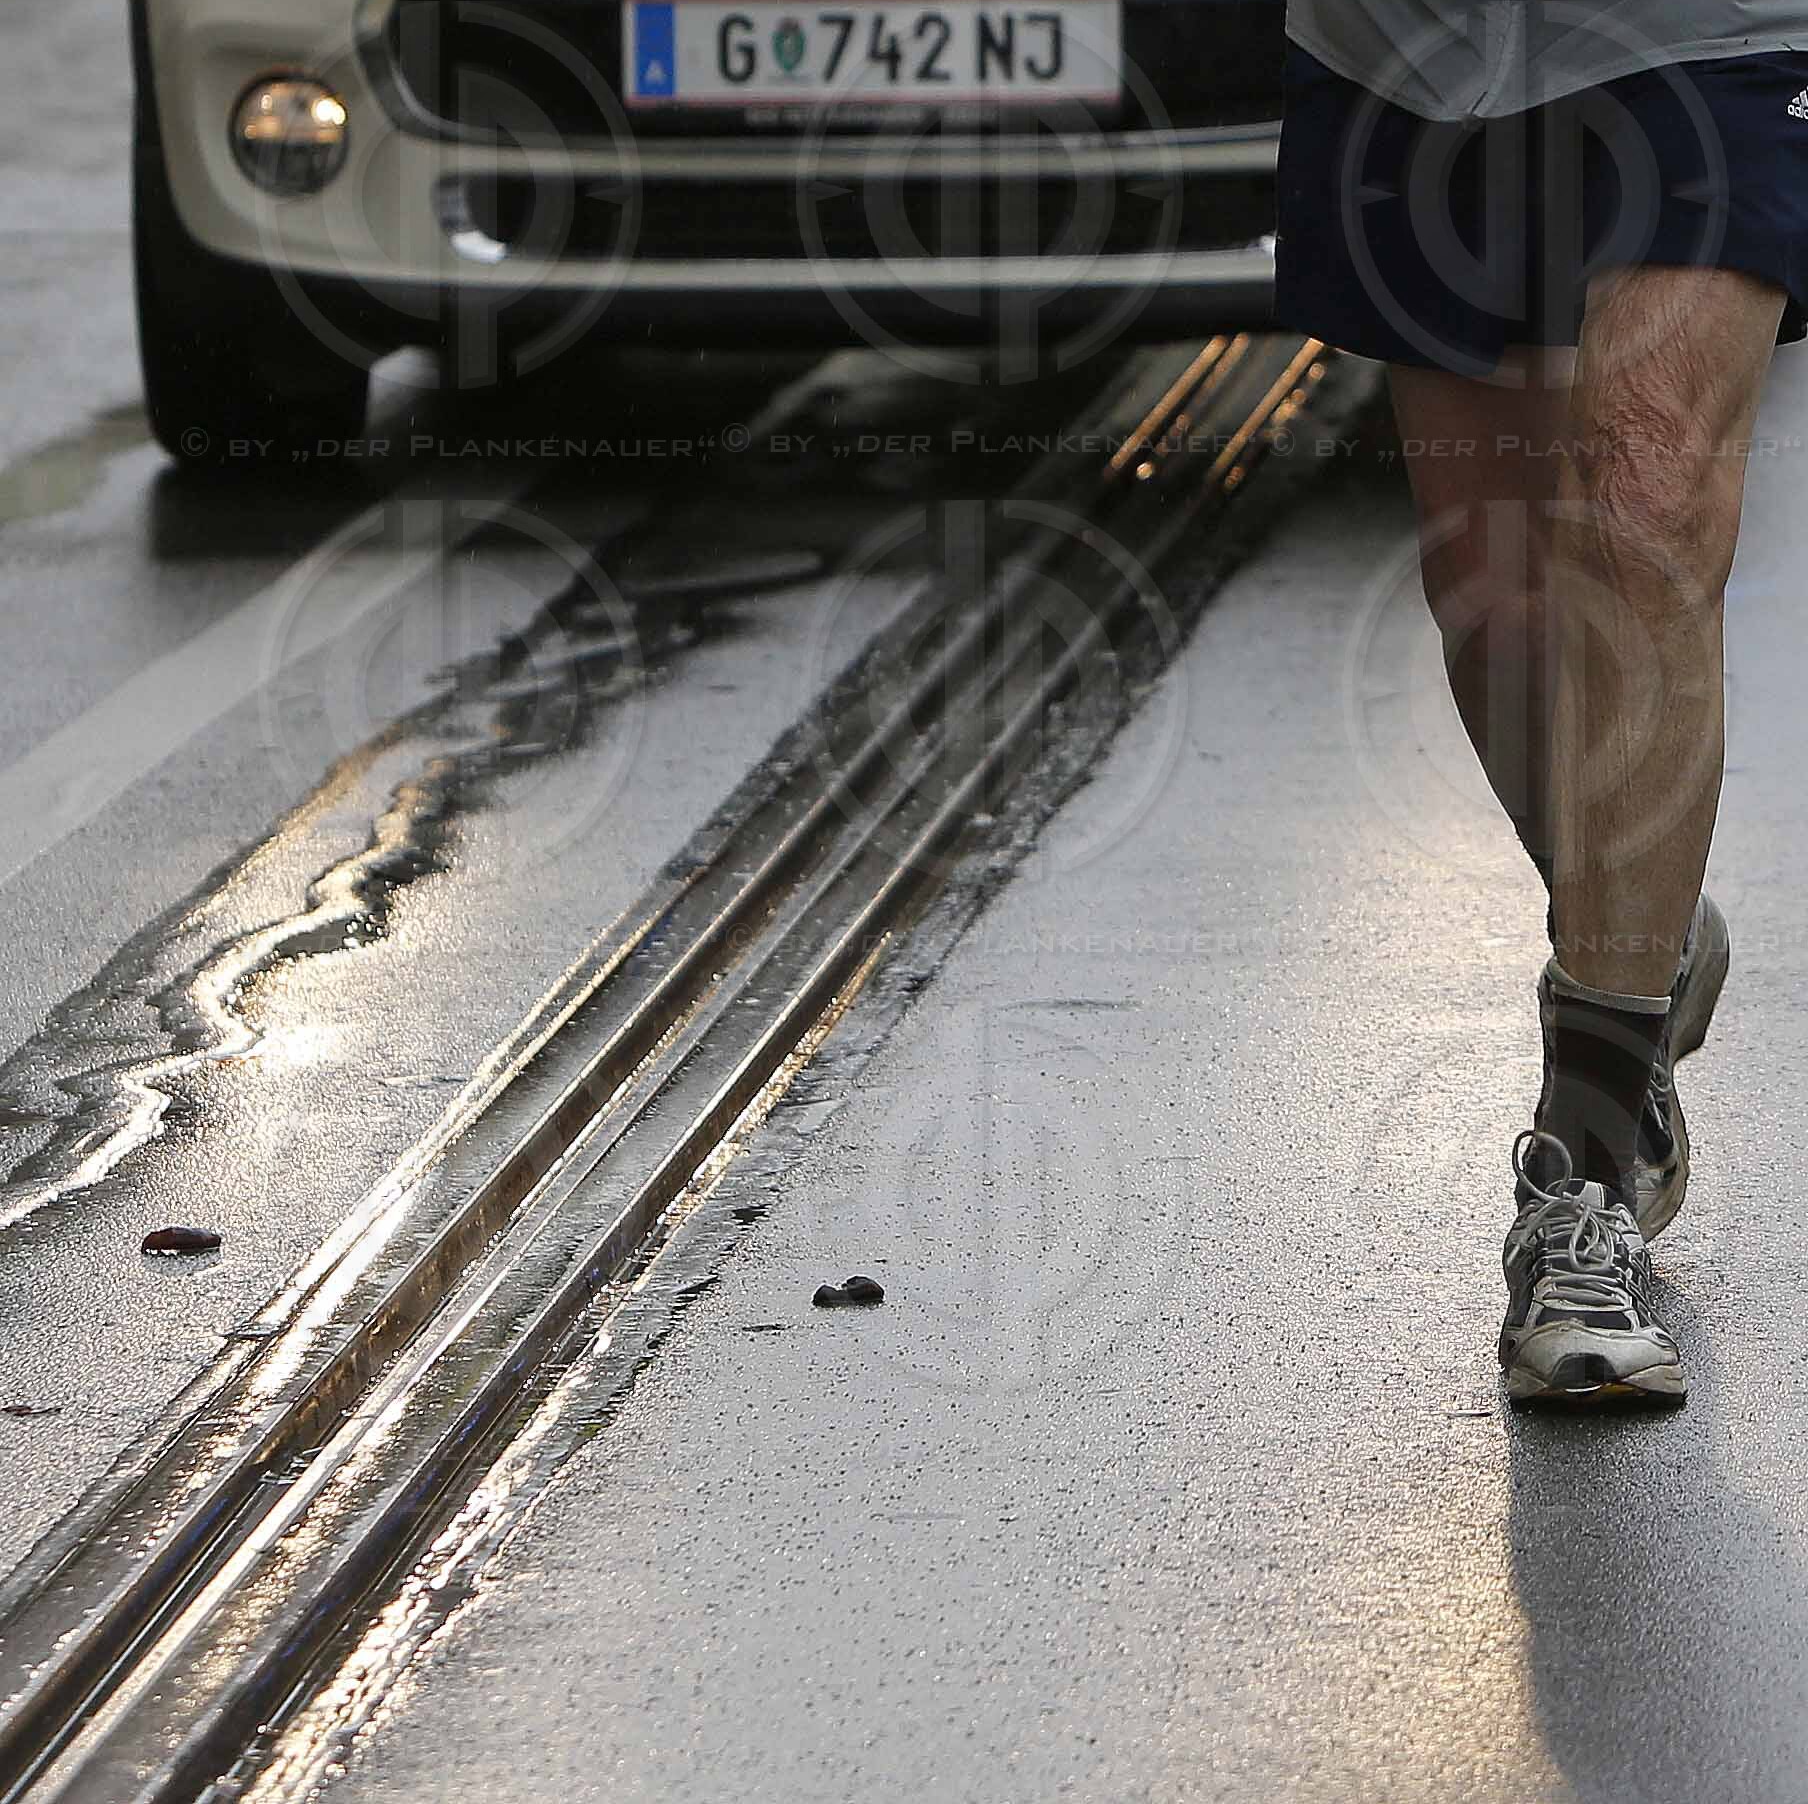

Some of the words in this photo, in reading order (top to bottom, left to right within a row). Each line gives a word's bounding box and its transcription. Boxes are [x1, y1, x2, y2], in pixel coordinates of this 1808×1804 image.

[718, 14, 755, 83] G
[817, 14, 952, 83] 742
[976, 11, 1064, 82] NJ
